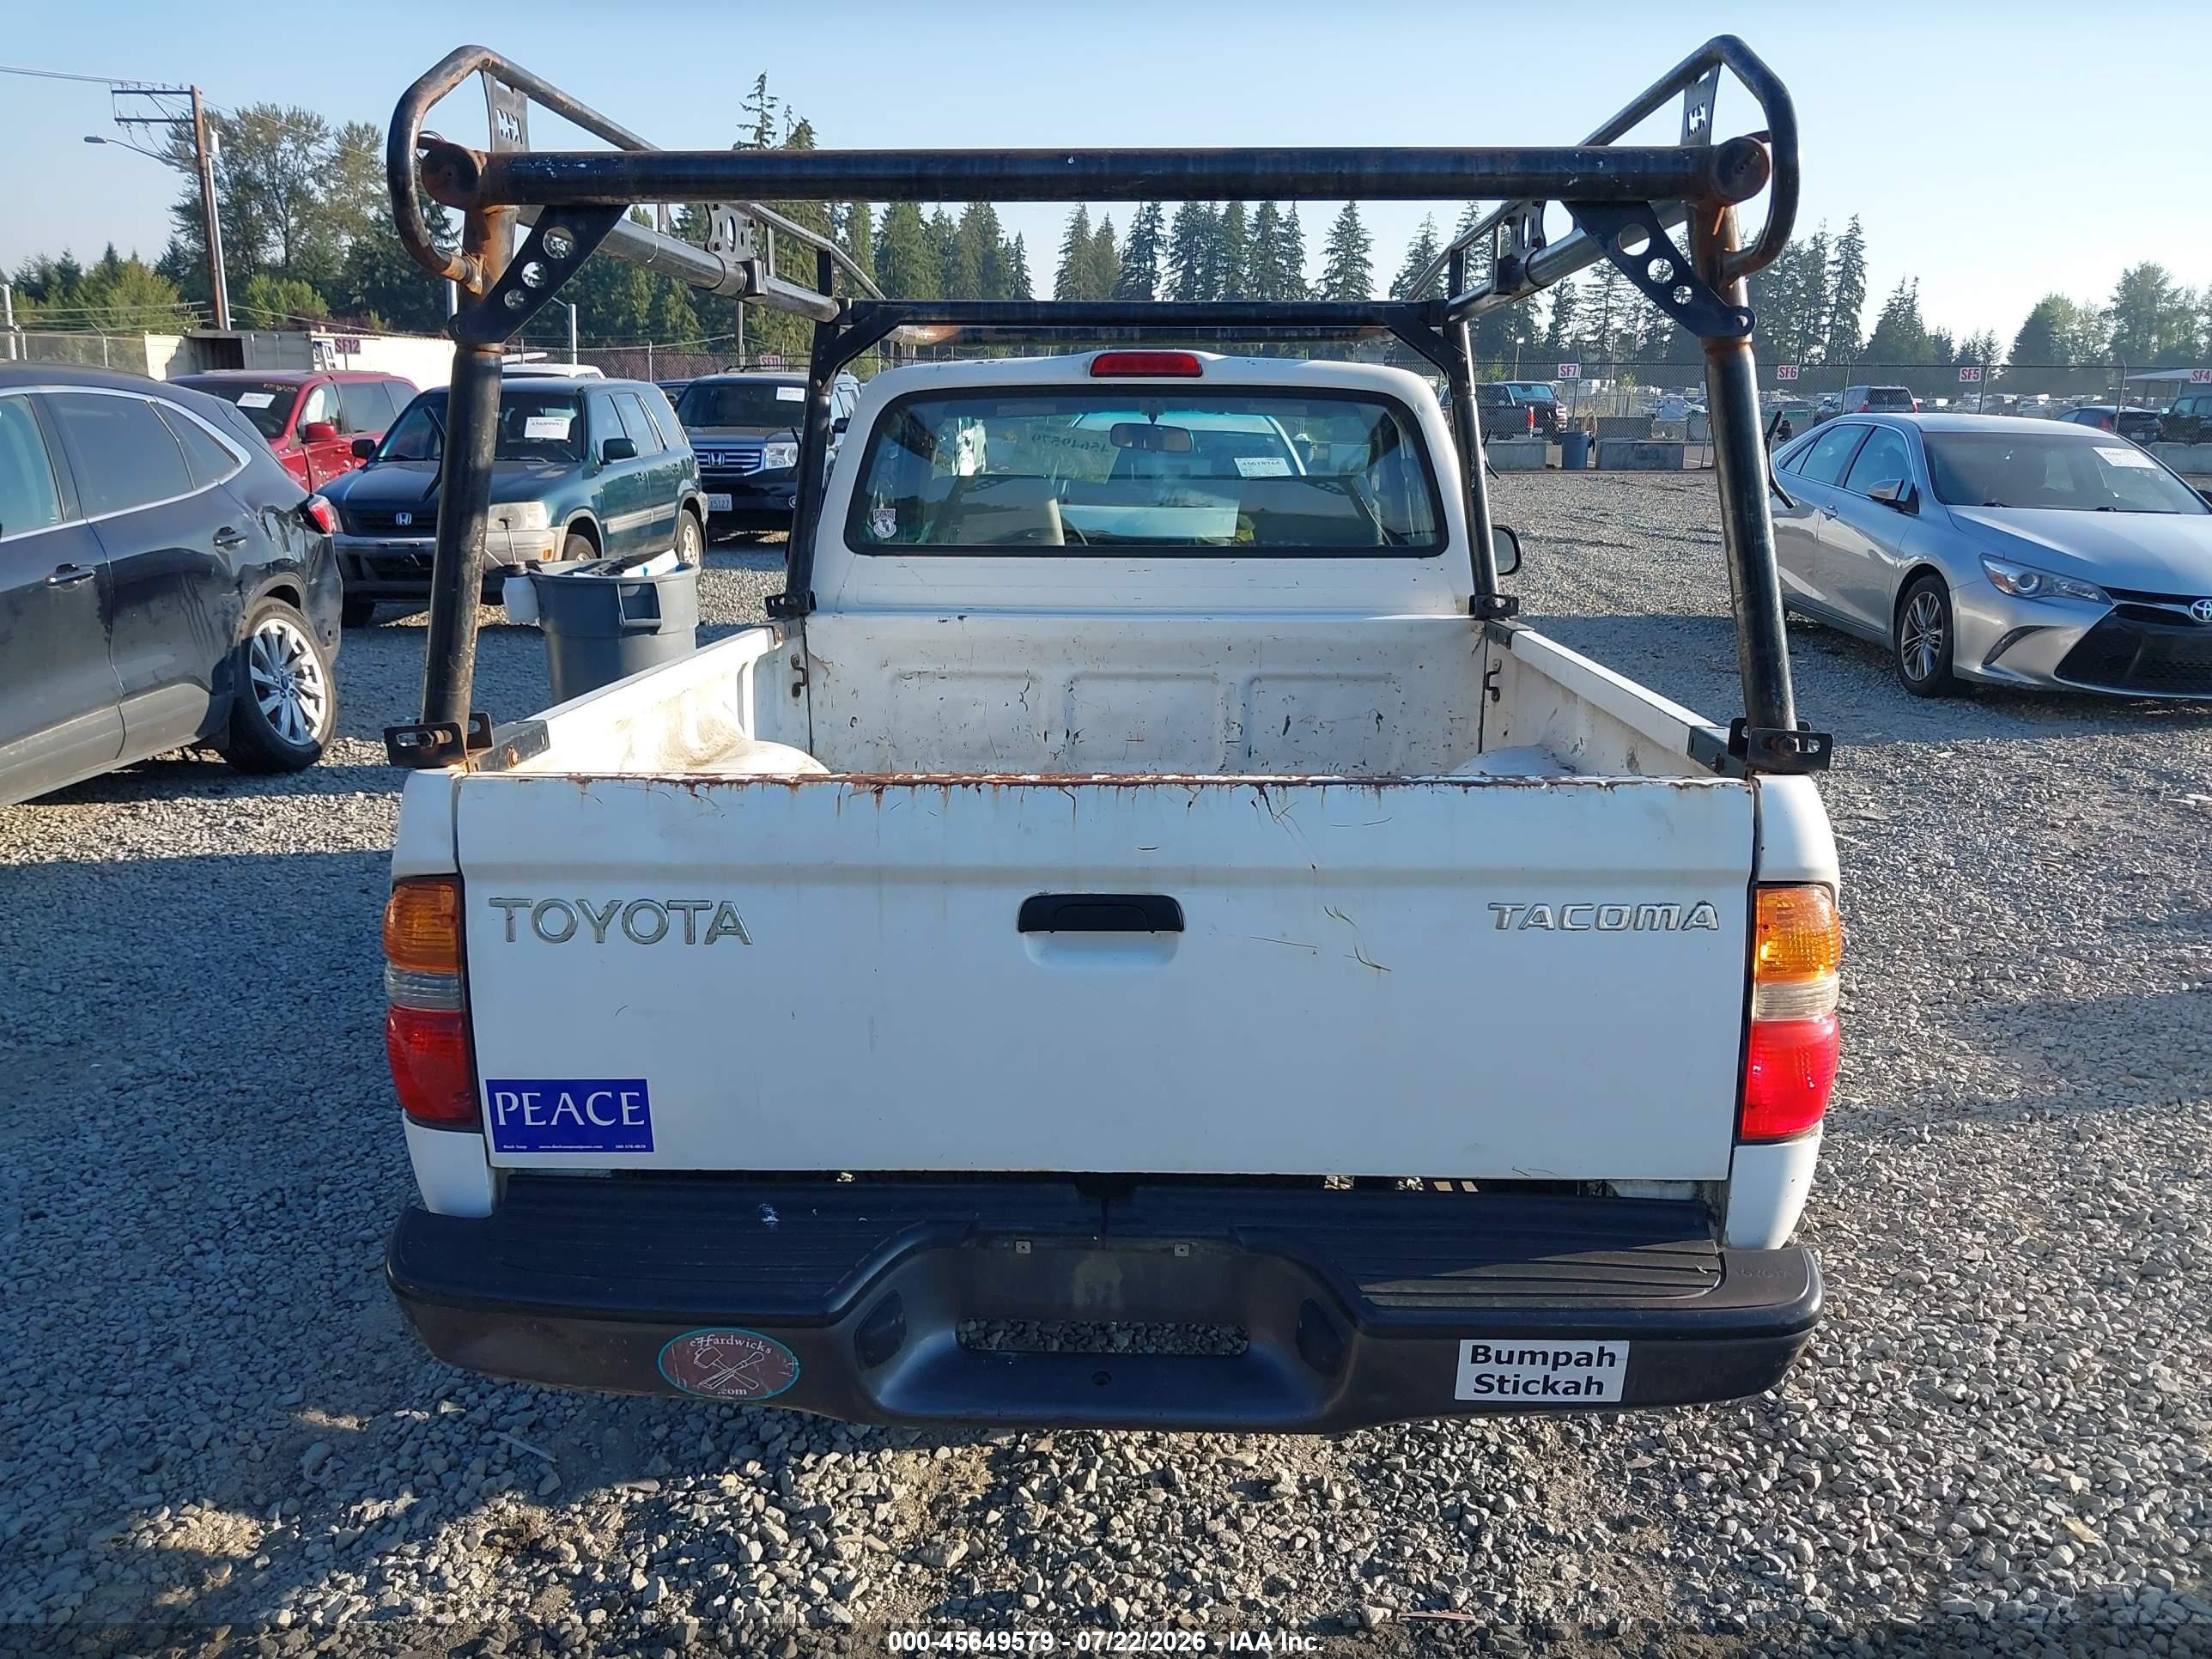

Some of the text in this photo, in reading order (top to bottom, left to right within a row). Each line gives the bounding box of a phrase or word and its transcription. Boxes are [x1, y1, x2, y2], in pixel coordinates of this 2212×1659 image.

[334, 338, 361, 353] SF12
[1559, 365, 1577, 377] SF7
[1778, 366, 1797, 379] SF6
[1960, 368, 1979, 380] SF5
[2191, 369, 2210, 382] SF4
[489, 897, 753, 945] TOYOTA
[1487, 901, 1718, 931] TACOMA
[494, 1091, 645, 1127] PEACE
[1470, 1345, 1617, 1371] Bumpah
[1473, 1373, 1604, 1395] Stickah
[717, 1388, 748, 1396] .com
